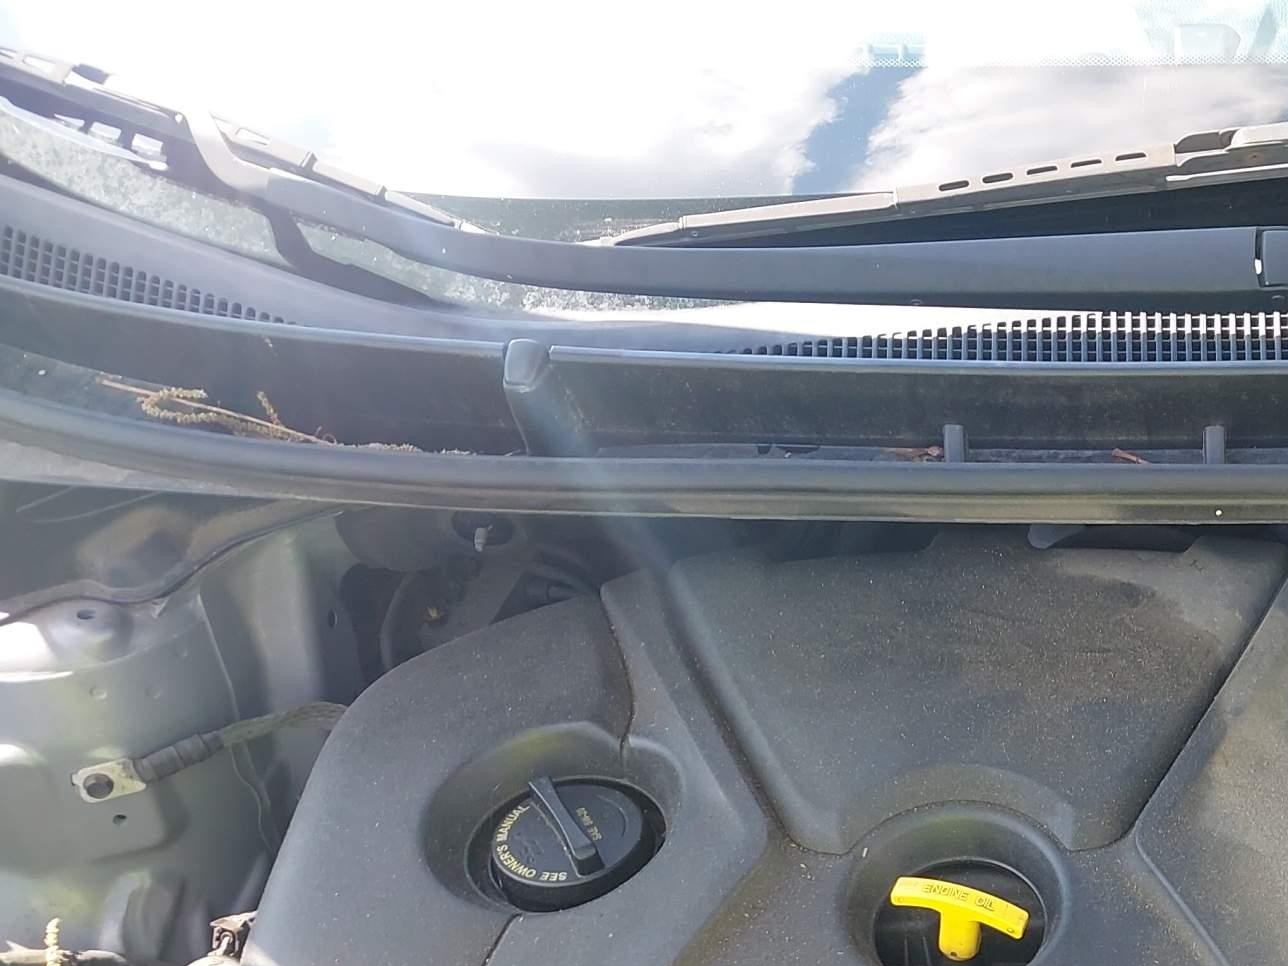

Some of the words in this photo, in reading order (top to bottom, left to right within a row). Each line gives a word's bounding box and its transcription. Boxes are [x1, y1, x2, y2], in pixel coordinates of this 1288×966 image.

[495, 805, 531, 842] MANUAL
[496, 844, 537, 880] OWNER'S
[539, 871, 568, 882] SEE
[921, 883, 970, 902] ENGINE
[974, 897, 995, 912] OIL
